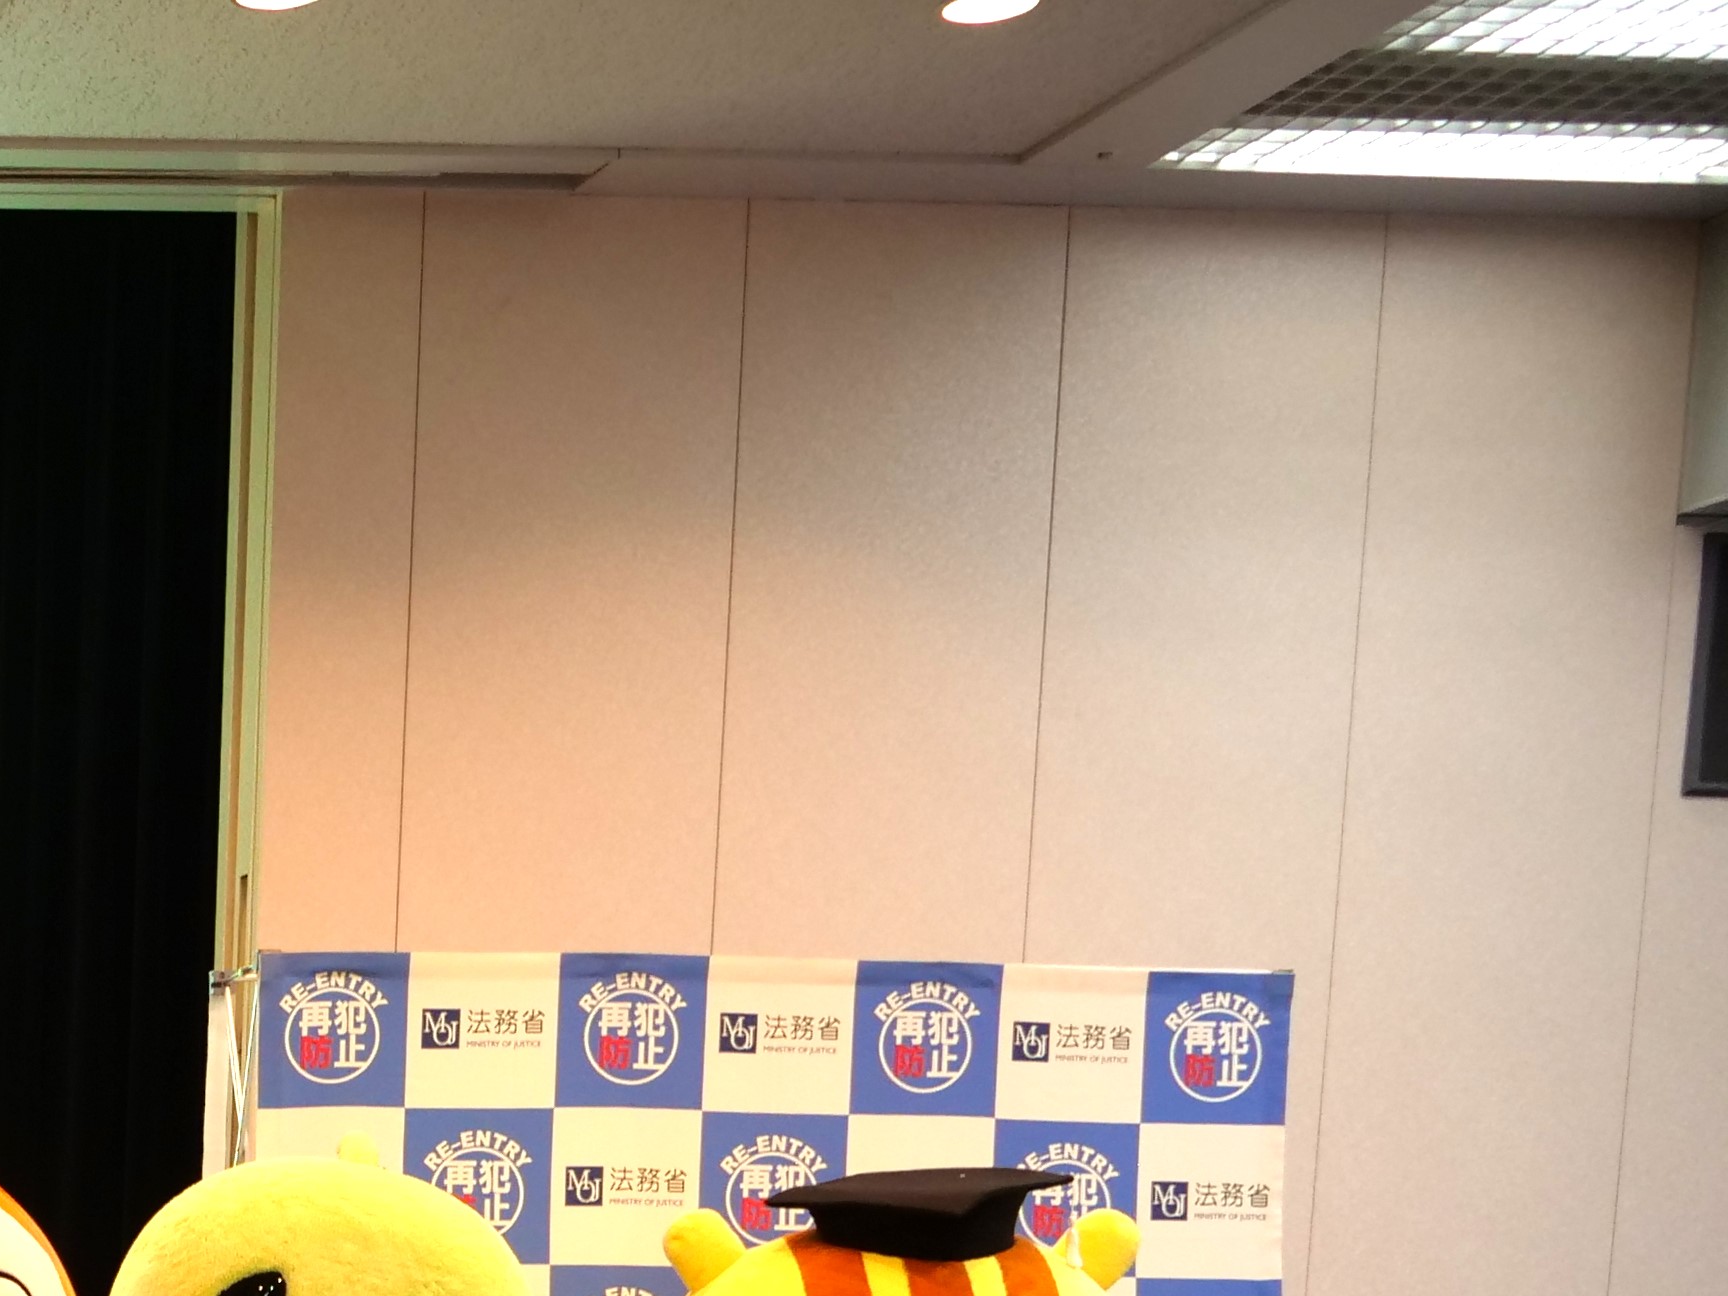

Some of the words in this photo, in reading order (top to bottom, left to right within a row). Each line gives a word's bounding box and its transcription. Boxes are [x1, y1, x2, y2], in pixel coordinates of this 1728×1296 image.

[279, 971, 389, 1014] RE-ENTRY
[578, 972, 687, 1013] RE-ENTRY
[874, 982, 981, 1022] RE-ENTRY
[299, 999, 367, 1036] 再犯
[466, 1009, 545, 1034] 法務省
[598, 1002, 665, 1037] 再犯
[764, 1014, 841, 1041] 法務省
[894, 1010, 959, 1046] 再犯
[1165, 992, 1271, 1032] RE-ENTRY
[1055, 1024, 1132, 1051] 法務省
[1184, 1020, 1248, 1056] 再犯
[424, 1130, 532, 1171] RE-ENTRY
[720, 1135, 828, 1175] RE-ENTRY
[444, 1159, 511, 1194] 再犯
[610, 1166, 687, 1194] 法務省
[1194, 1182, 1270, 1208] 法務省
